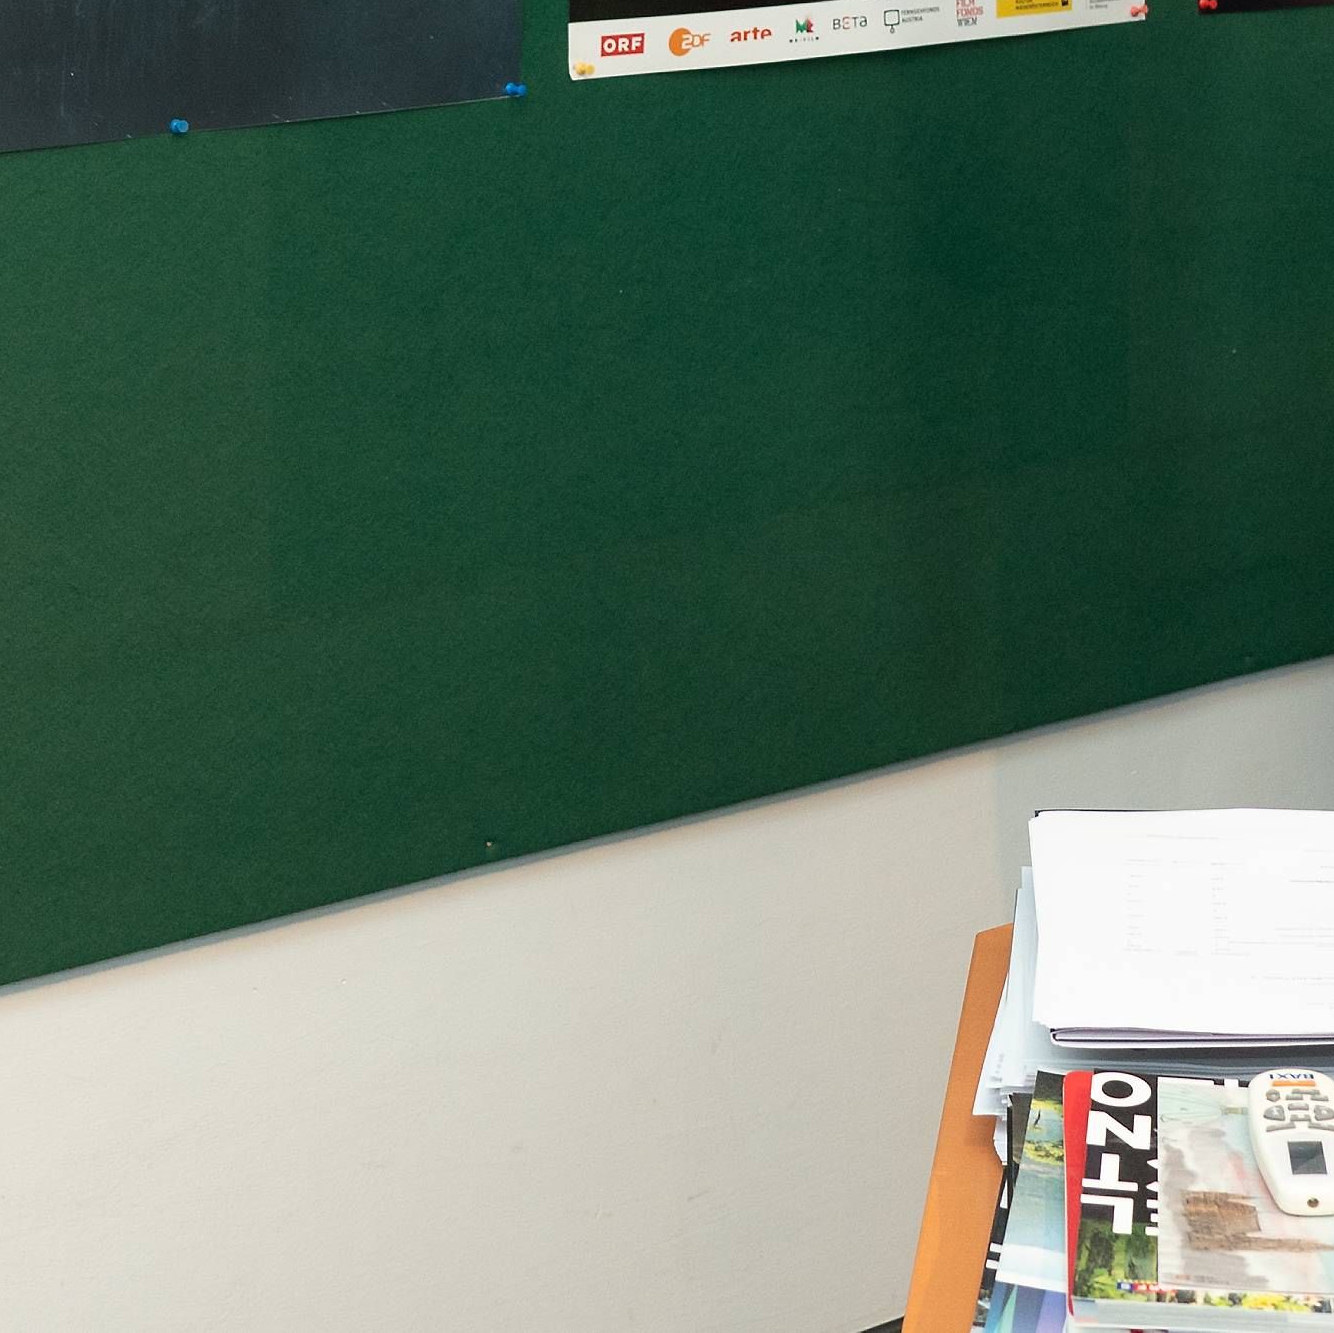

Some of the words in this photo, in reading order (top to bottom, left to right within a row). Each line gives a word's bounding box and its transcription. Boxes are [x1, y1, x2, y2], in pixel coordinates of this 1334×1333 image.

[603, 36, 643, 53] ORF
[681, 33, 711, 50] ZDF
[730, 27, 772, 42] arte
